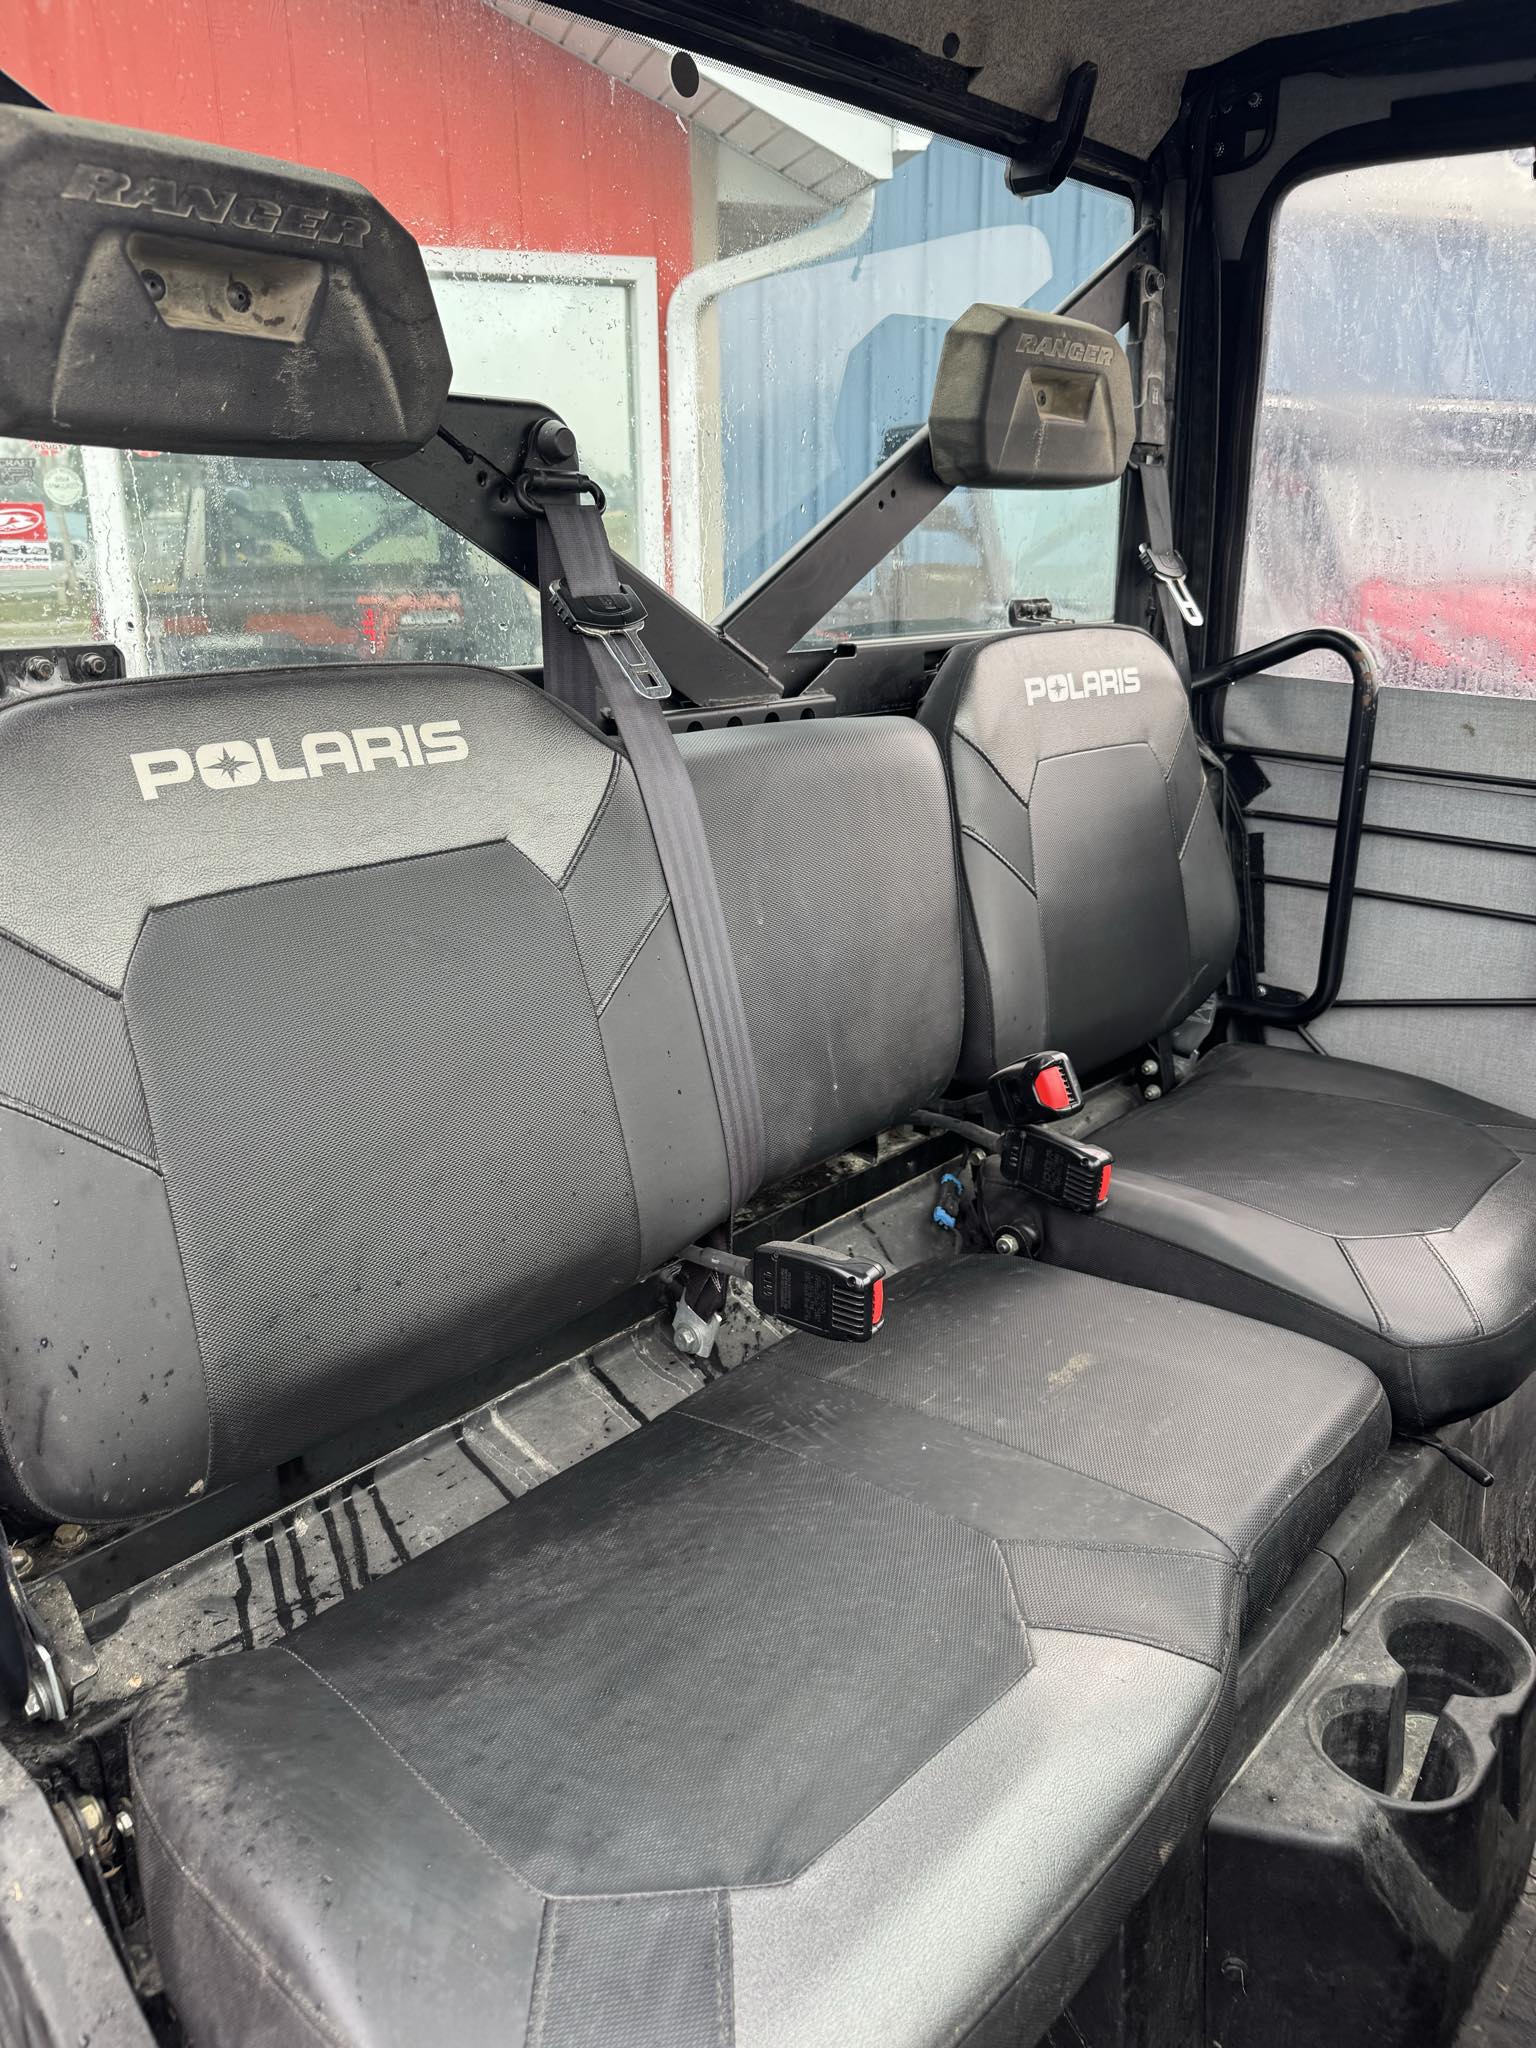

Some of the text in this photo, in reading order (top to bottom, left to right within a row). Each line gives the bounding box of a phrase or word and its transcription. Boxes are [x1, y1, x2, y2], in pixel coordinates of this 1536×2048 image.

[60, 162, 372, 249] RANGER
[1015, 332, 1114, 367] RANGER
[1023, 667, 1141, 706] POLARIS
[129, 719, 470, 801] POLARIS
